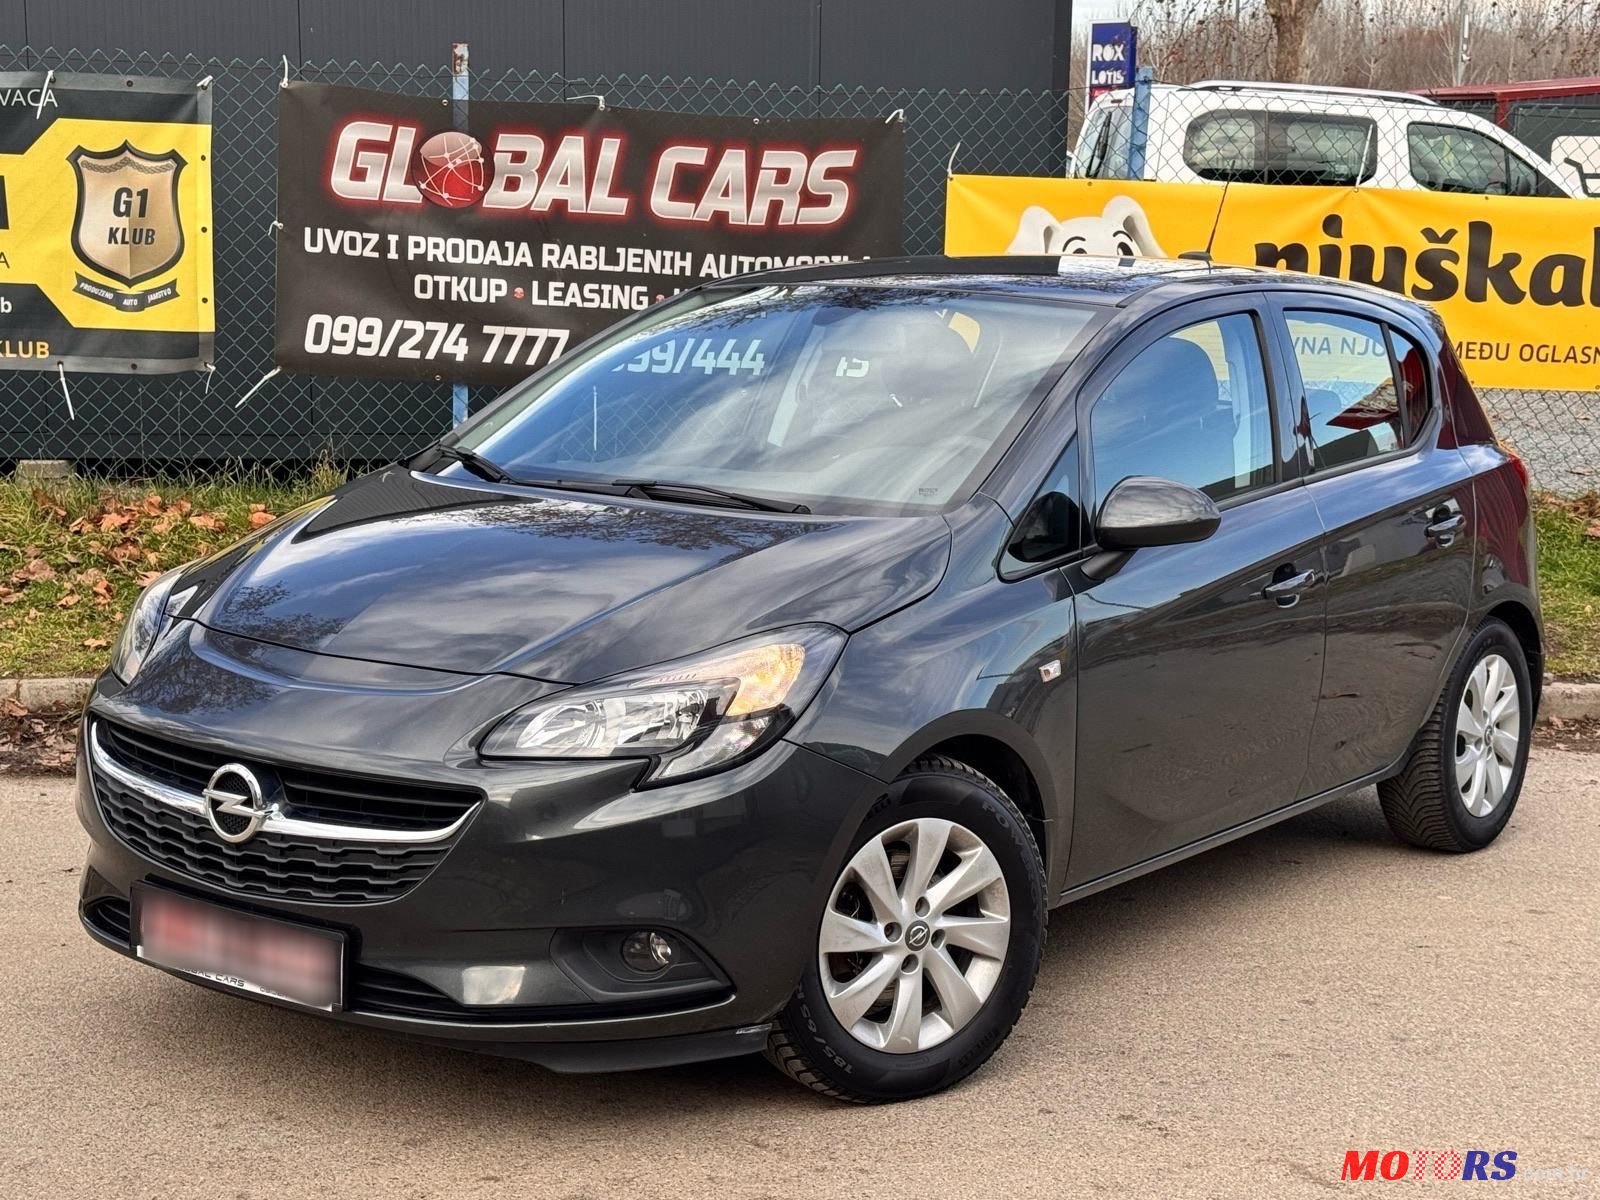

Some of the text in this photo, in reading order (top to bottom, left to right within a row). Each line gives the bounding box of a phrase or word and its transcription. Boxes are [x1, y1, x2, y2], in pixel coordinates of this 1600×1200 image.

[330, 120, 857, 226] GLOBAL CARS
[112, 187, 149, 219] G1
[107, 226, 156, 246] KLUB
[304, 226, 380, 258] UVOZ
[387, 233, 399, 260] I
[407, 235, 534, 268] PRODAJA
[541, 242, 692, 277] RABLJENIH
[414, 274, 649, 311] OTKUP LEASING
[304, 313, 571, 366] 099/274 7777
